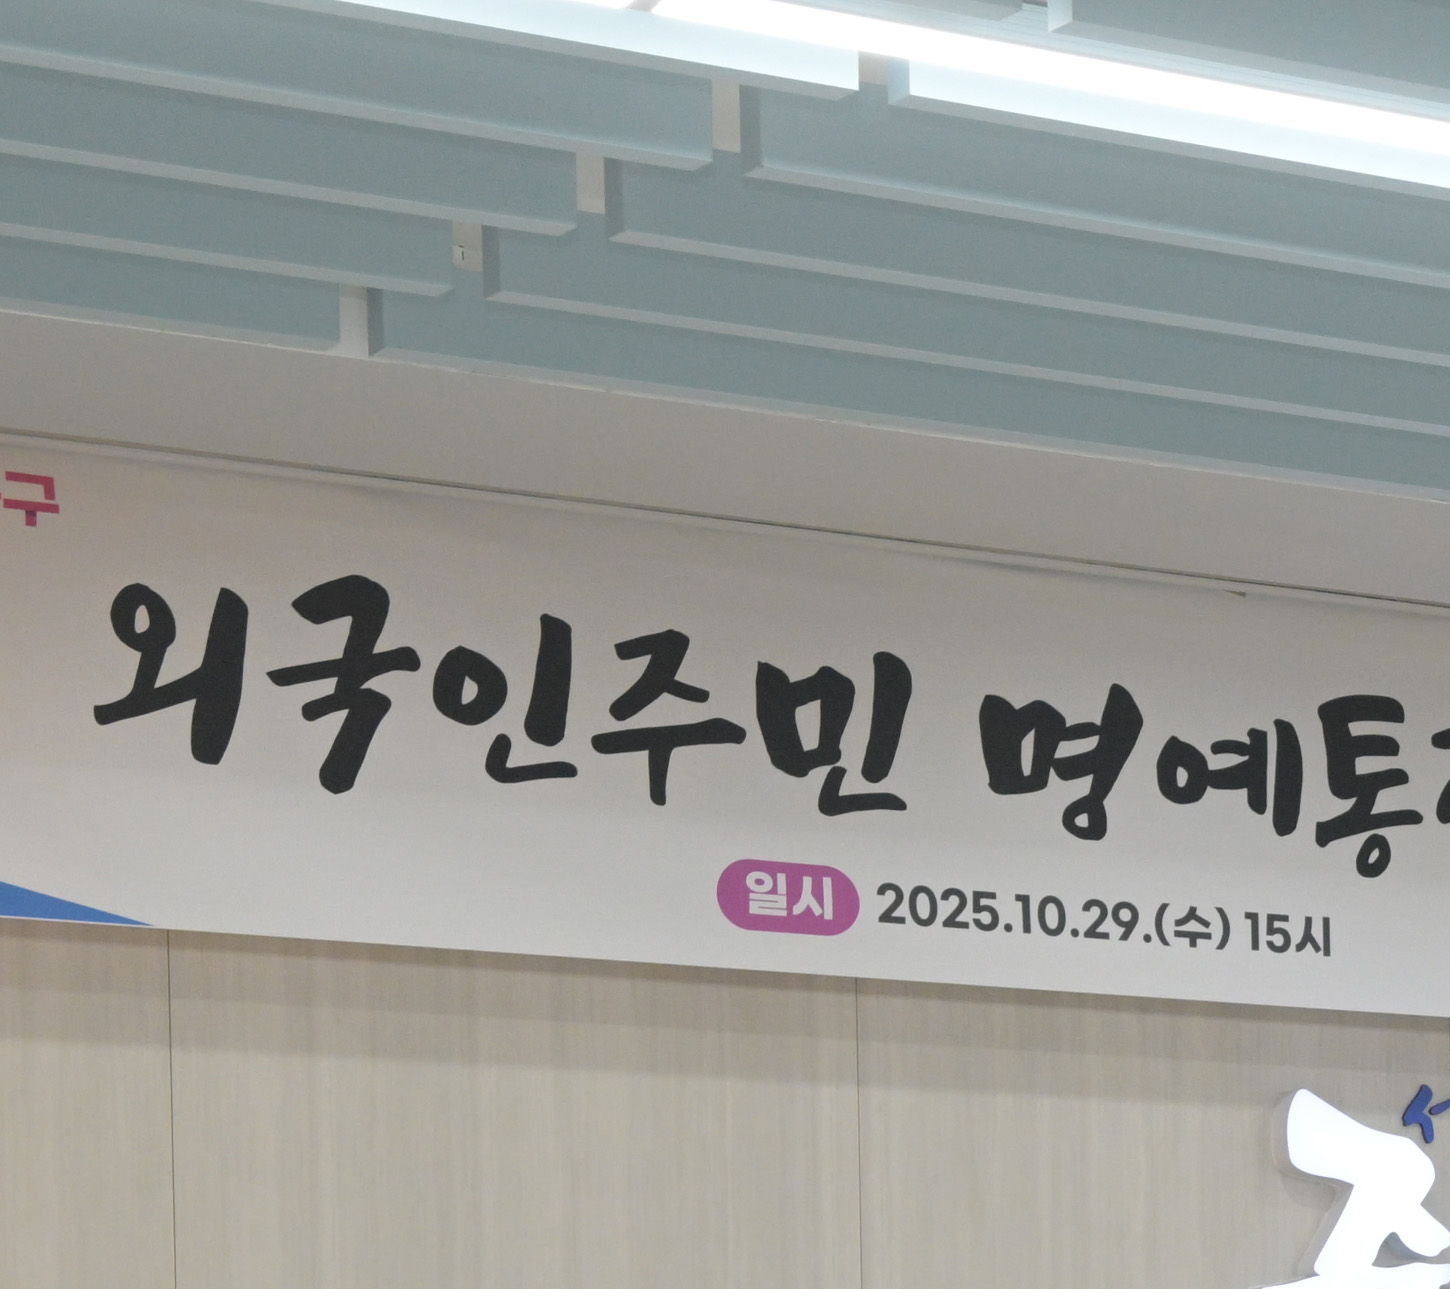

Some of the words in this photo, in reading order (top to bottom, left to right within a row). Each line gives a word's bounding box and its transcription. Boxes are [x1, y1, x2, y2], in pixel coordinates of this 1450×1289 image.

[0, 471, 60, 528] 구
[93, 574, 913, 817] 외국인주민
[745, 871, 833, 920] 일시
[876, 882, 1231, 950] 2025.10.29.(수)
[1244, 910, 1332, 957] 15시
